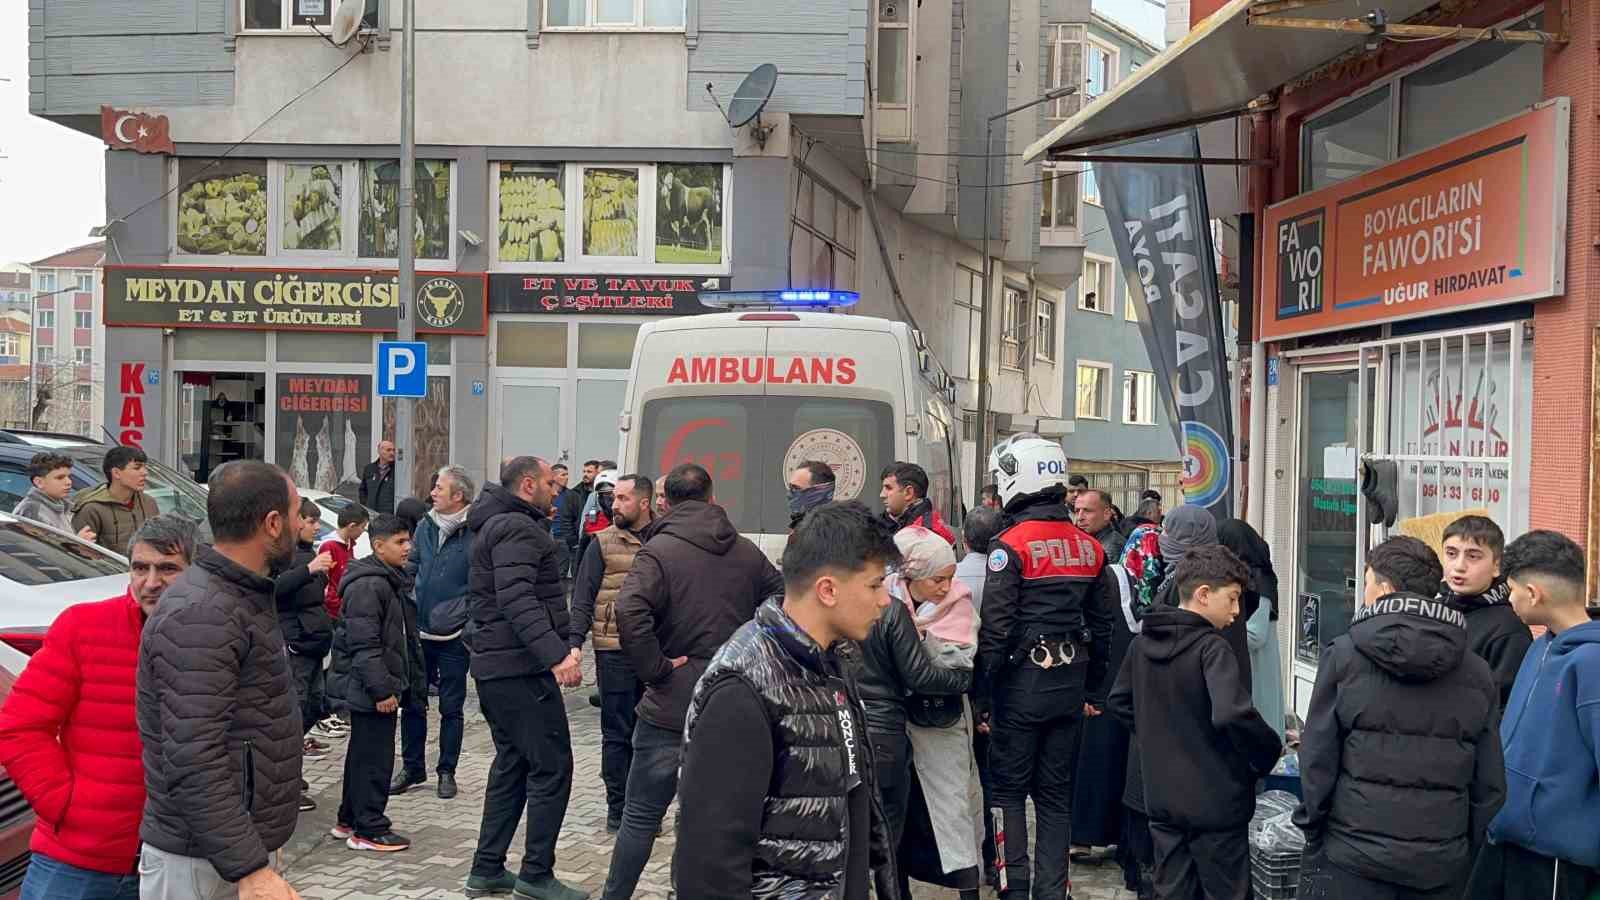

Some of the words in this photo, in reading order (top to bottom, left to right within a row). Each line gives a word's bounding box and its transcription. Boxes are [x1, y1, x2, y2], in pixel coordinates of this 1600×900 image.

[1363, 178, 1483, 238] BOYACILARIN
[1278, 221, 1301, 254] FA
[1289, 245, 1322, 282] WO
[125, 277, 246, 304] MEYDAN
[253, 274, 400, 308] CİĞERCİSİ
[523, 278, 556, 290] ET
[564, 278, 598, 290] VE
[605, 278, 696, 292] TAVUK
[1384, 281, 1429, 305] UĞUR
[1434, 265, 1506, 296] HIRDAVAT
[177, 309, 204, 322] ET
[209, 310, 227, 322] &
[232, 310, 258, 323] ET
[263, 309, 362, 326] ÜRÜNLERİ
[287, 378, 359, 393] MEYDAN
[387, 347, 416, 391] P
[667, 357, 857, 385] AMBULANS
[838, 709, 857, 775] MONCLER
